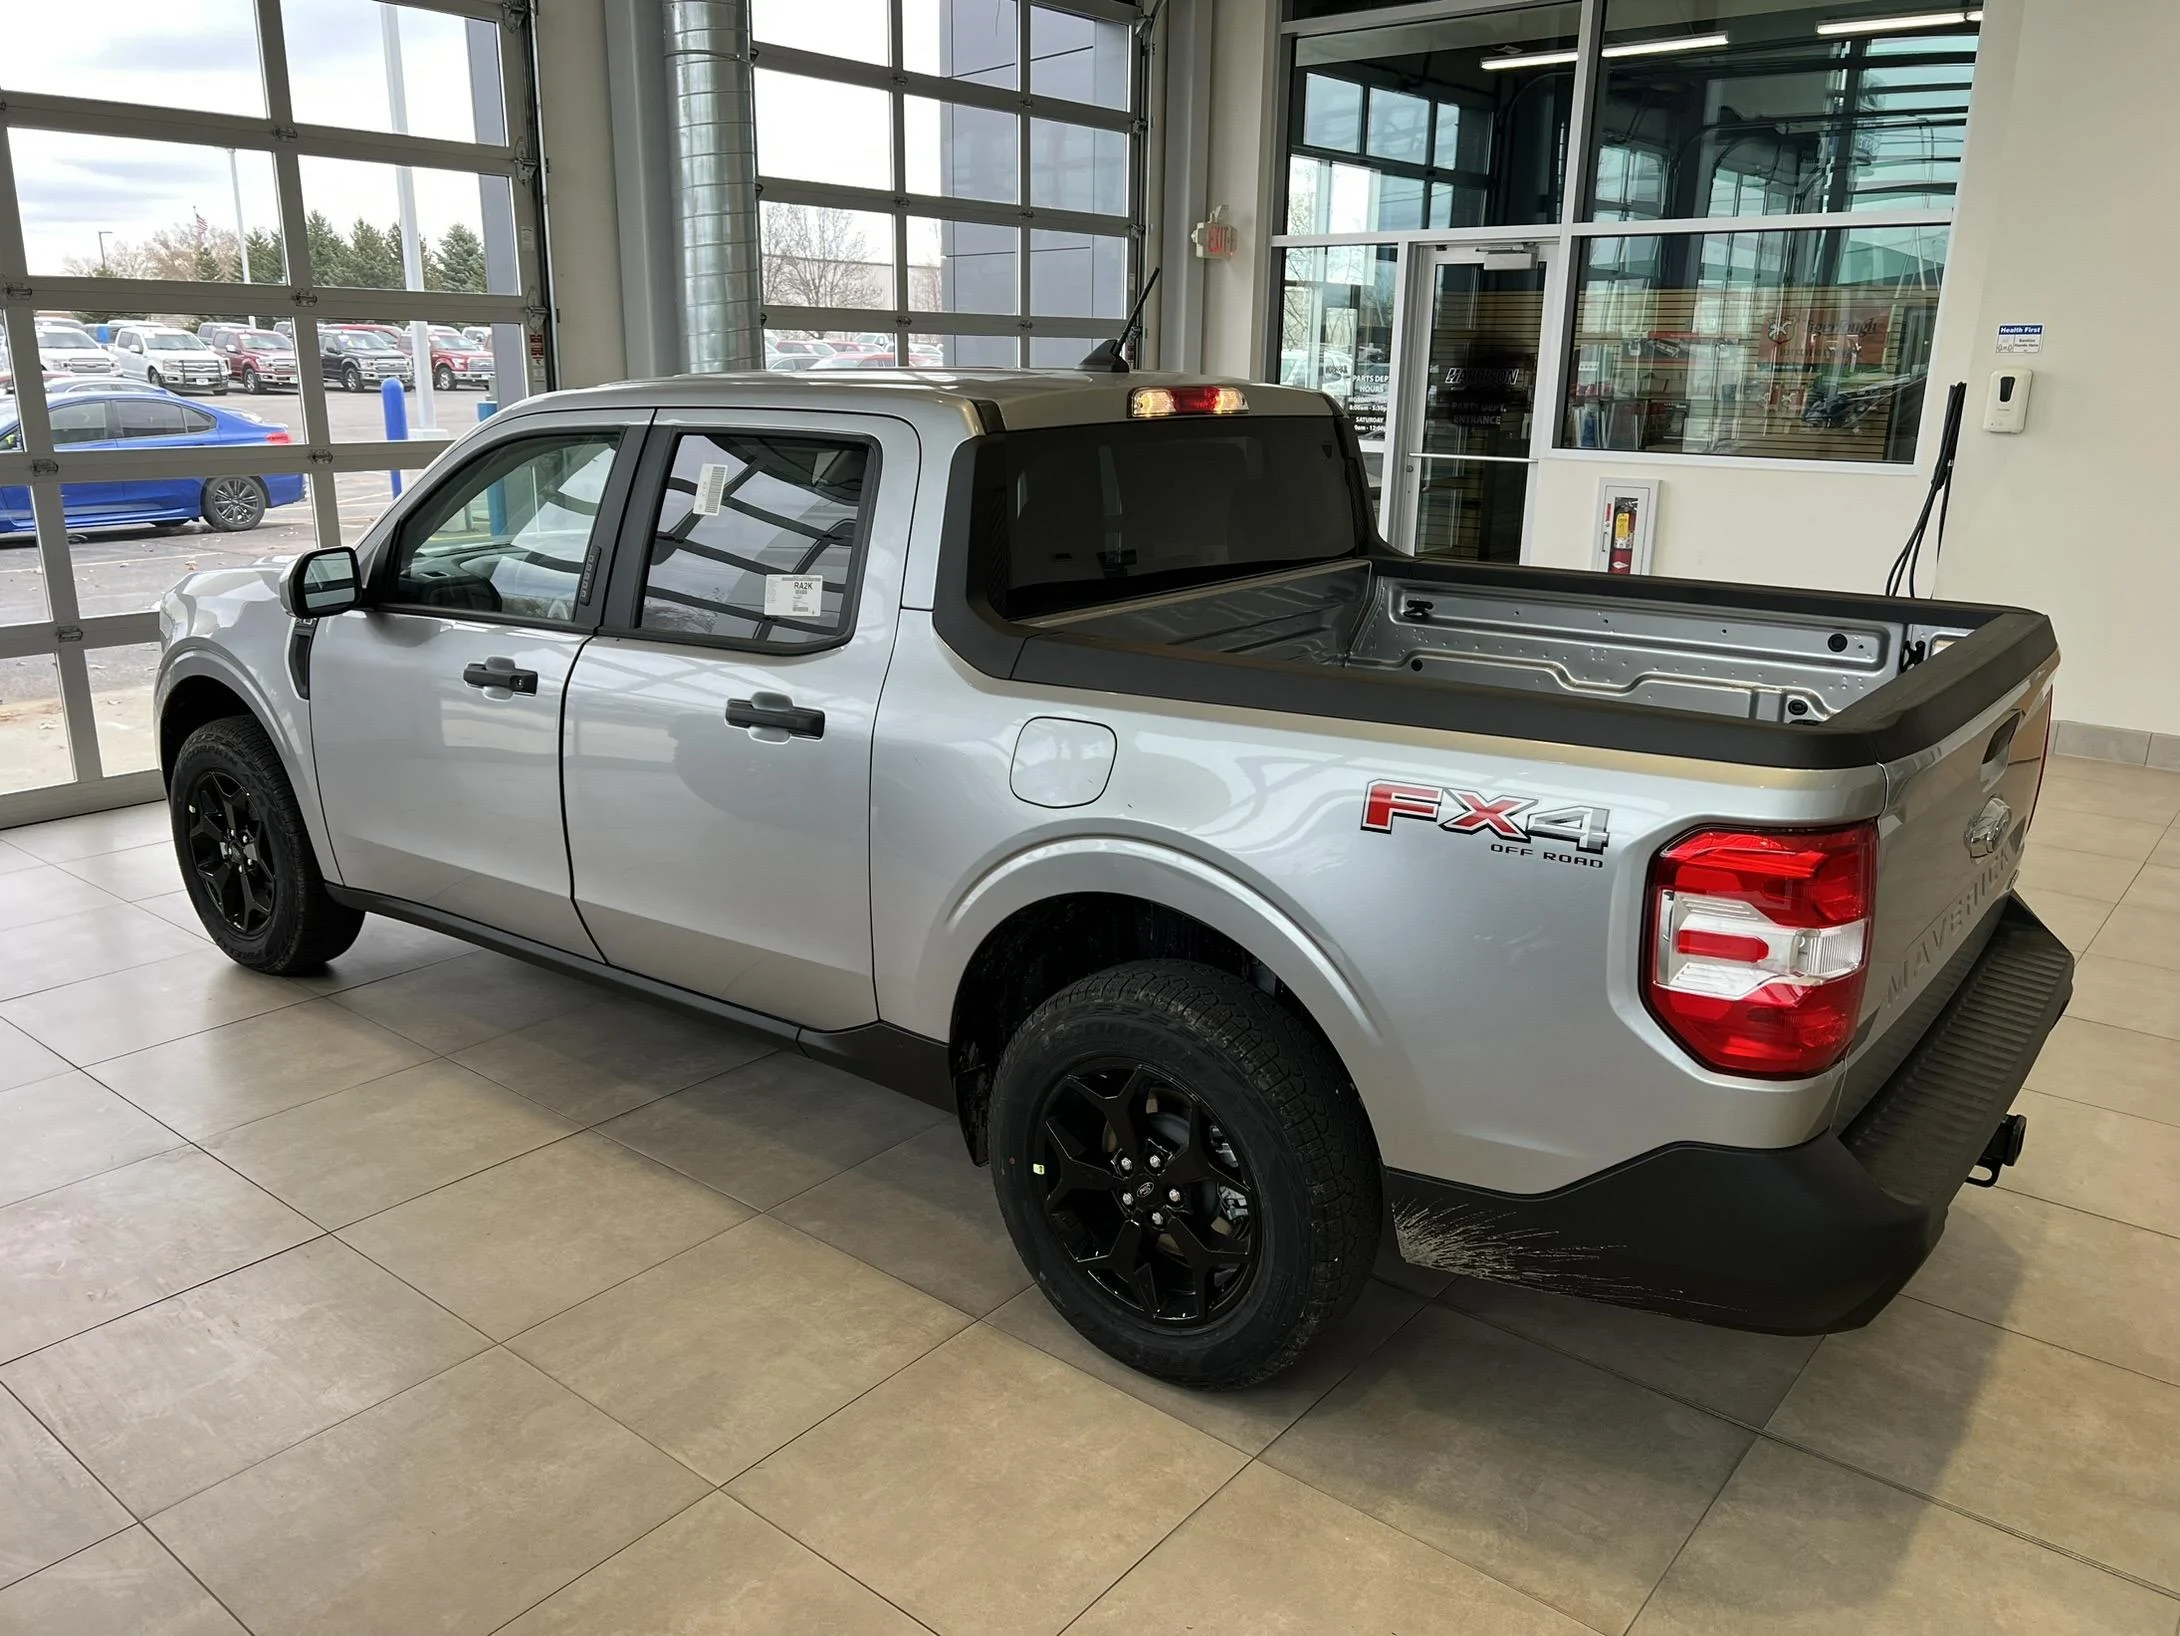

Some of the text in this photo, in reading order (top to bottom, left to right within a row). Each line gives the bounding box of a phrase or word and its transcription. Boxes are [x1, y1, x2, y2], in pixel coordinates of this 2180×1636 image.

[2000, 326, 2023, 334] Health
[1352, 375, 1374, 383] PARTS
[1359, 385, 1384, 393] HOURS
[1453, 415, 1502, 425] ENTRANCE
[793, 581, 813, 590] RA2K
[1360, 778, 1610, 855] FX4
[1490, 843, 1604, 868] OFF ROAD
[1886, 847, 2010, 1008] MAVERICK
